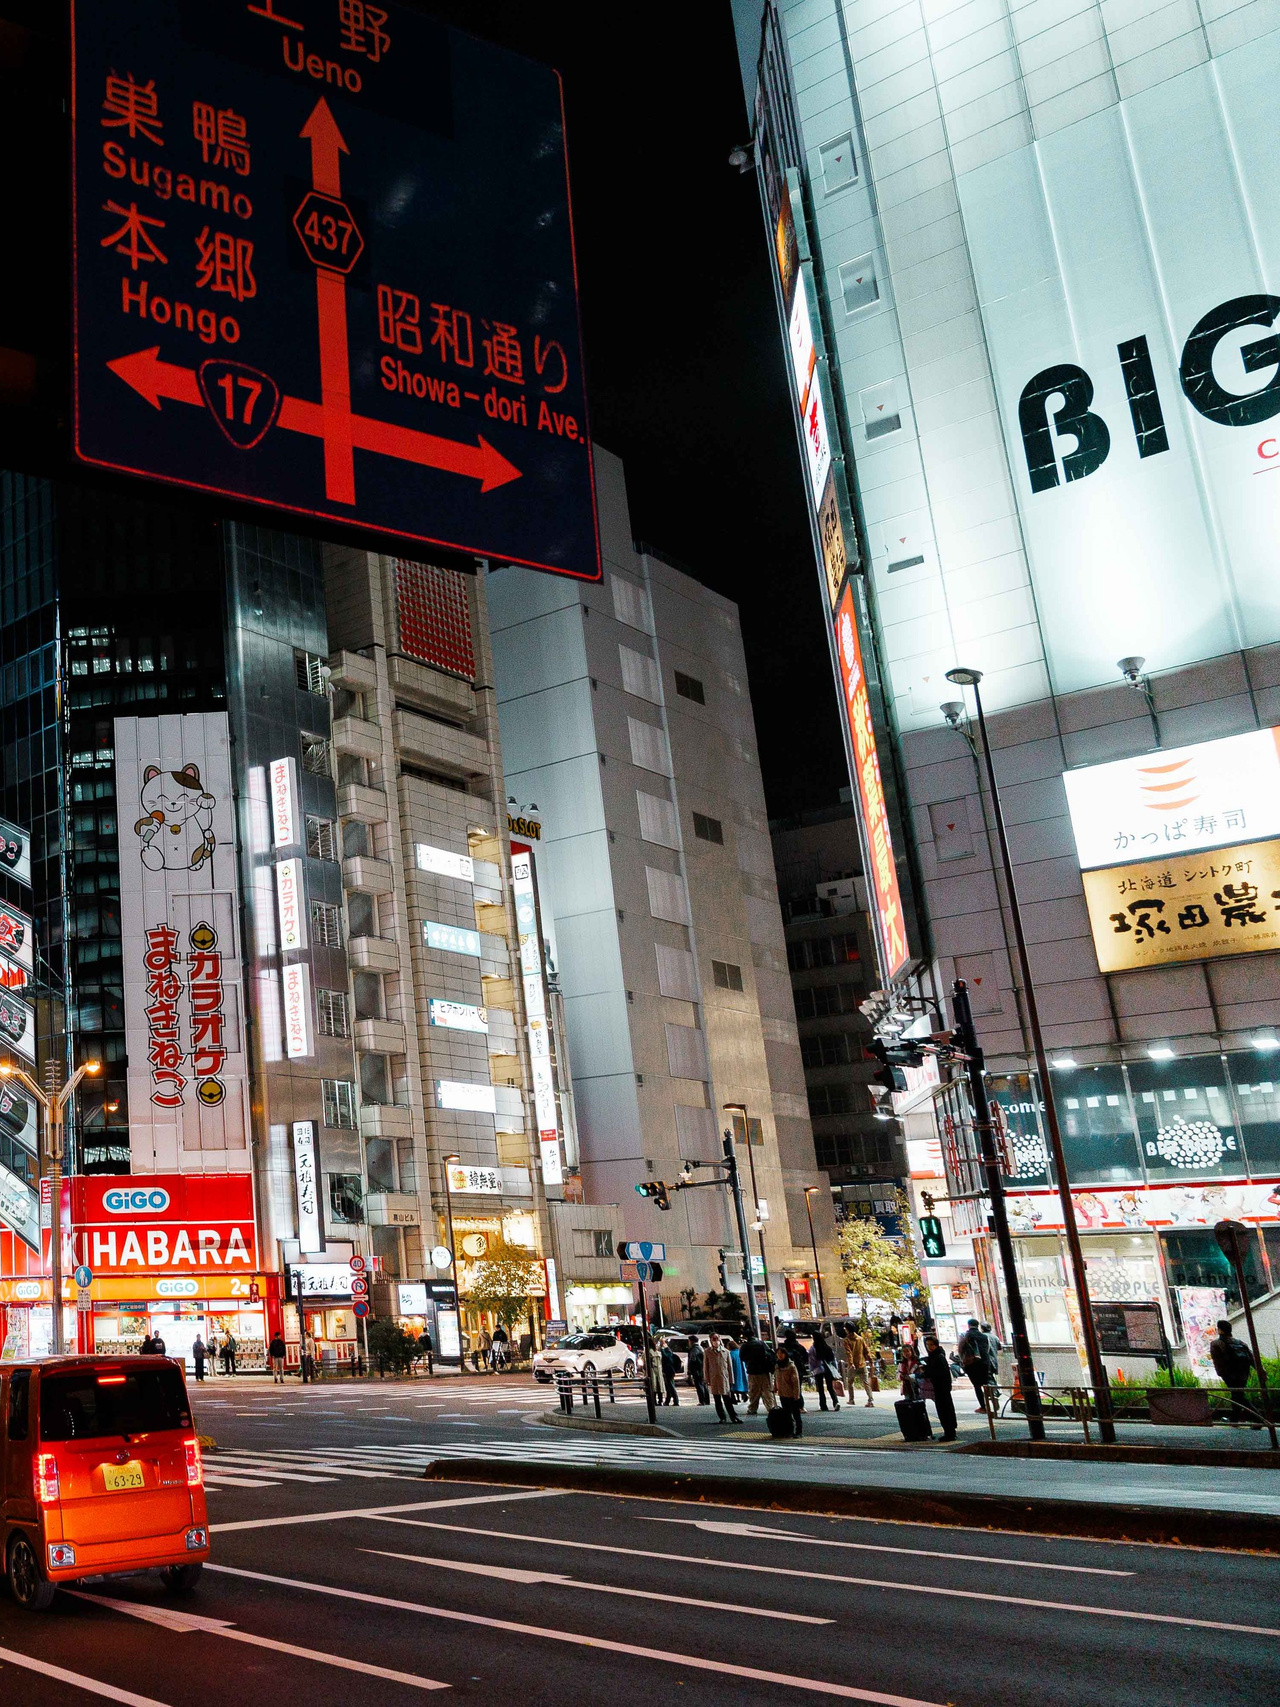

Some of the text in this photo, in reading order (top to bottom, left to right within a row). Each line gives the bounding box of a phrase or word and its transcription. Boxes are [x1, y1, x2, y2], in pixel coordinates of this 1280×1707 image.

[283, 36, 363, 93] Ueno
[101, 69, 252, 177] 巣鴨
[102, 141, 253, 220] Sugamo
[101, 199, 257, 303] 本郷
[304, 210, 353, 256] 437
[122, 279, 241, 344] Hongo
[378, 284, 568, 394] 昭和通り
[217, 373, 265, 425] 17
[381, 355, 585, 444] Showa-dori Ave.
[1018, 294, 1280, 494] BIG
[275, 762, 290, 842] まねきねこ
[1113, 808, 1248, 850] かっぱ寿司
[282, 878, 296, 932] カラオケ
[1118, 871, 1177, 895] 北海道
[1184, 860, 1253, 882] シントク町
[144, 923, 188, 1109] まねきねこ
[187, 952, 227, 1076] カラオケ
[287, 970, 303, 1052] まねきねこ
[106, 1191, 168, 1210] GiGO
[17, 1284, 41, 1296] GiGO
[159, 1281, 196, 1294] GiGO
[352, 1260, 362, 1268] 40
[114, 1473, 142, 1487] 63-29
